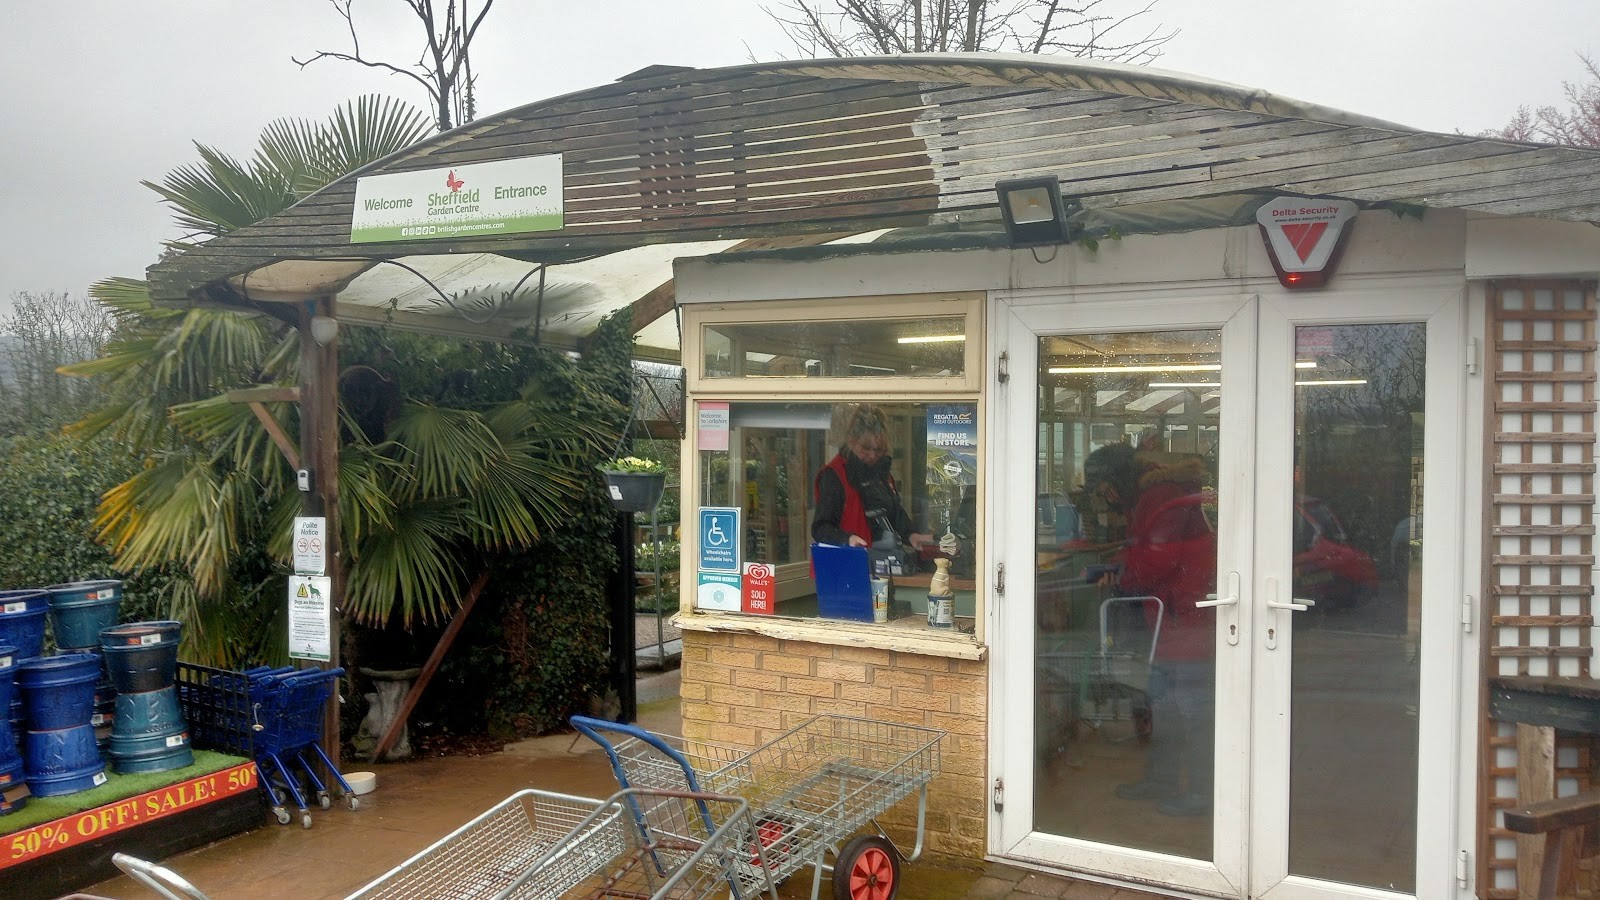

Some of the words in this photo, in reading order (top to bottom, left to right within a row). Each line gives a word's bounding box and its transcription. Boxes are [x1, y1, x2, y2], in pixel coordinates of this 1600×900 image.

[427, 188, 480, 207] Sheffield
[494, 184, 547, 200] Entrance
[364, 197, 413, 212] Welcome
[427, 207, 454, 216] Garden
[454, 205, 480, 214] Centre
[1272, 209, 1297, 217] Delta
[1299, 206, 1339, 215] Security
[437, 222, 505, 234] britishgardencentres.com
[937, 432, 956, 440] FIND
[956, 432, 967, 440] US
[750, 590, 767, 600] SOLD
[750, 600, 767, 610] HERE!
[11, 823, 70, 859] 50%
[77, 801, 139, 836] OFF!
[145, 777, 217, 817] SALE!
